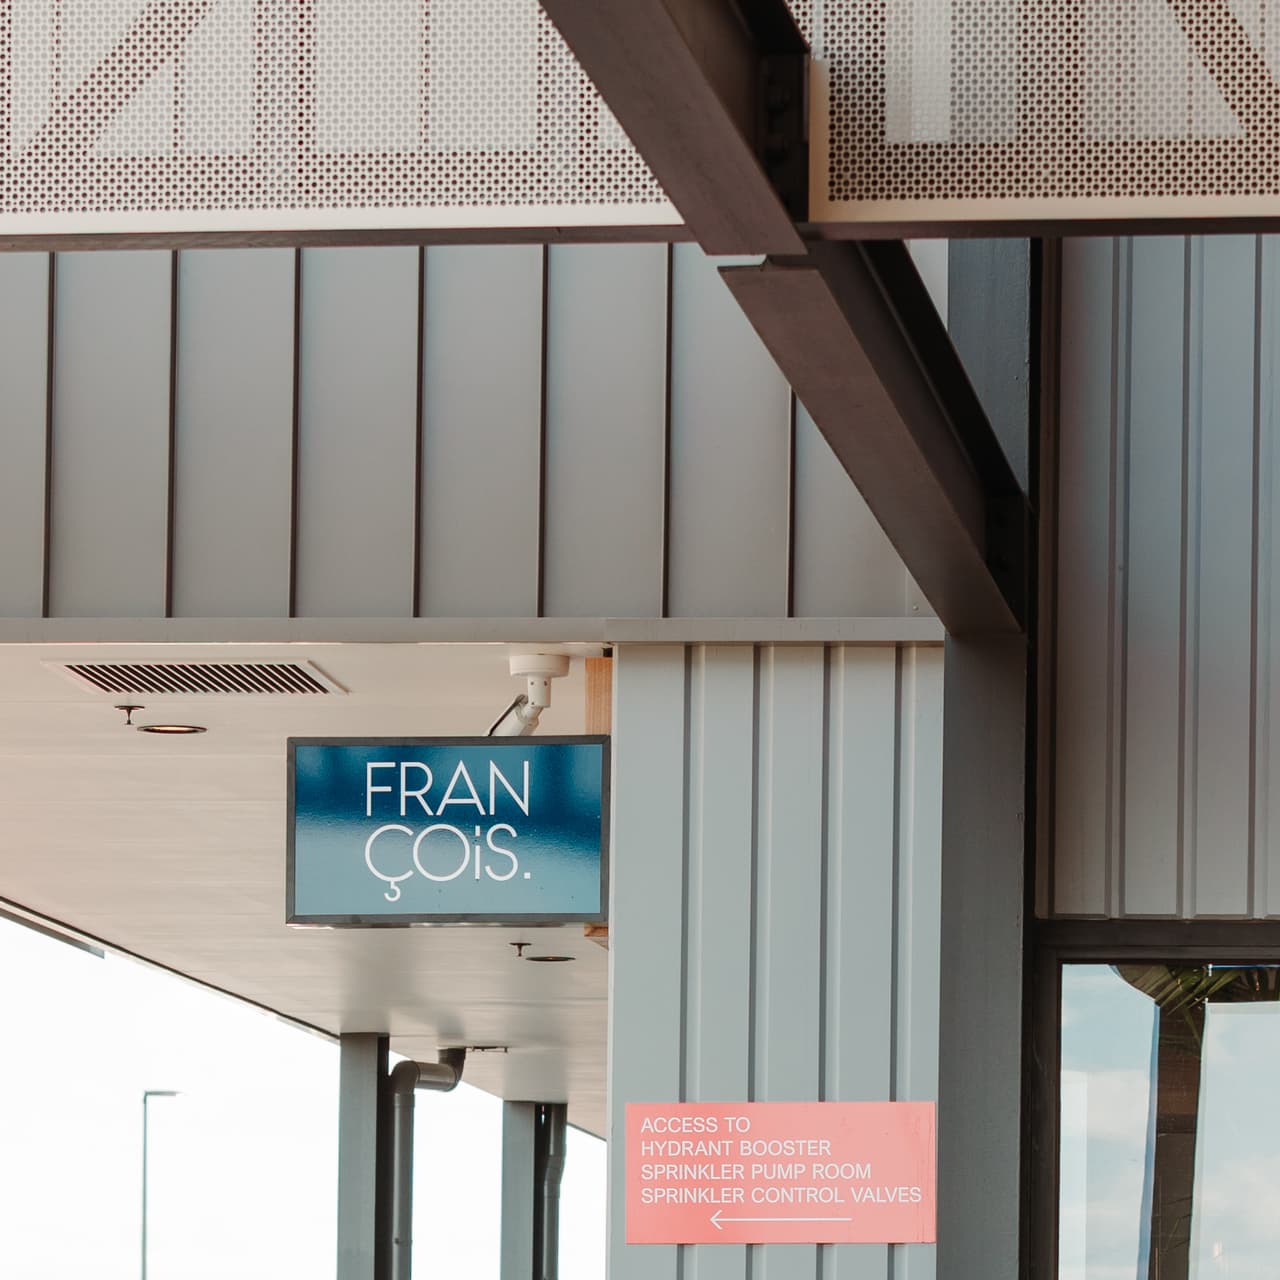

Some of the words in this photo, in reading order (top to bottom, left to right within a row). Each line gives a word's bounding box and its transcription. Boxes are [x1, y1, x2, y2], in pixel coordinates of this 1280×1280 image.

[366, 760, 529, 817] FRAN
[640, 1116, 719, 1133] ACCESS
[723, 1116, 751, 1133] TO
[641, 1140, 734, 1157] HYDRANT
[739, 1140, 832, 1156] BOOSTER
[641, 1163, 745, 1180] SPRINKLER
[751, 1163, 806, 1180] PUMP
[812, 1163, 872, 1180] ROOM
[640, 1187, 745, 1204] SPRINKLER
[751, 1186, 845, 1204] CONTROL
[850, 1186, 923, 1203] VALVES
